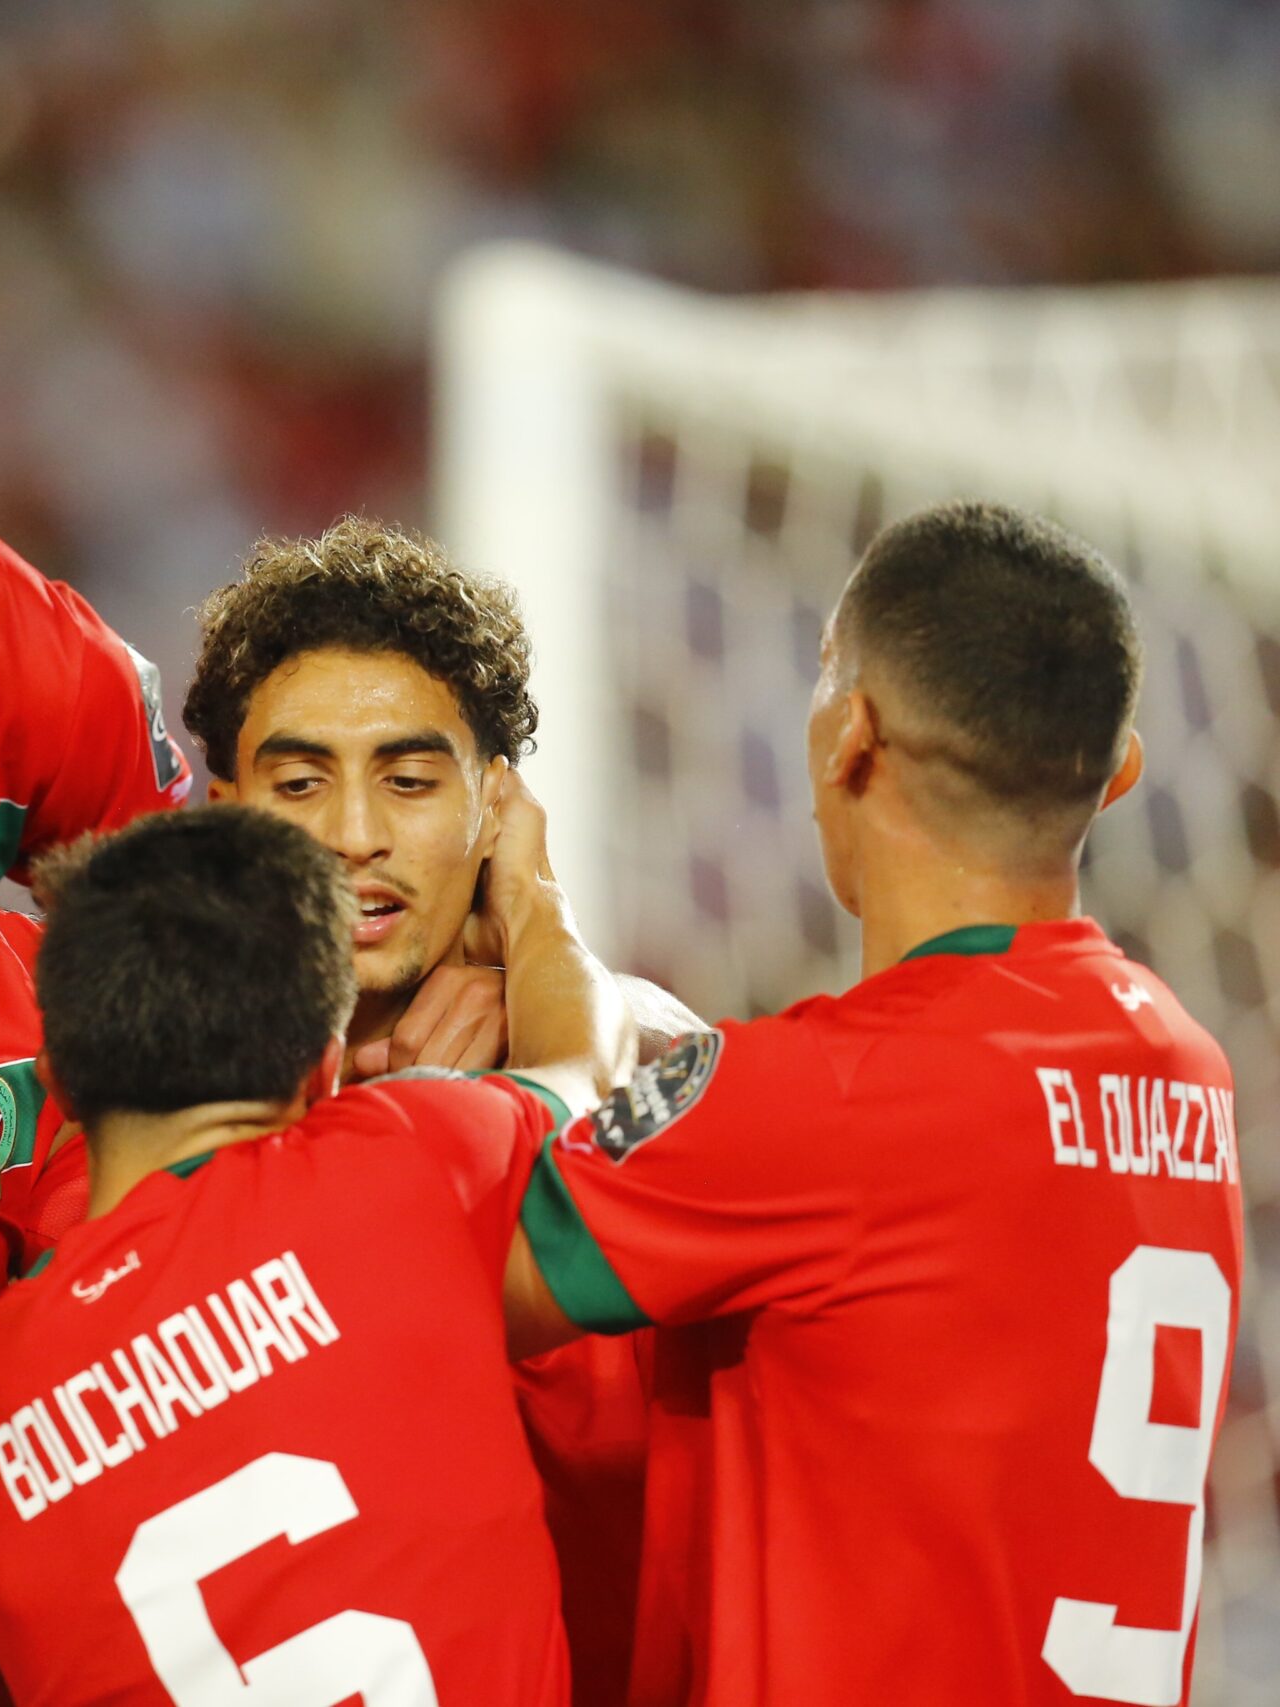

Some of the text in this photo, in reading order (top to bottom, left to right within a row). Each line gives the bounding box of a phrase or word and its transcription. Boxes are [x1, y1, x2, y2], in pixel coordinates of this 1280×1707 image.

[1036, 1067, 1097, 1168] EL
[115, 1451, 438, 1707] 6
[1041, 1245, 1232, 1706] 9
